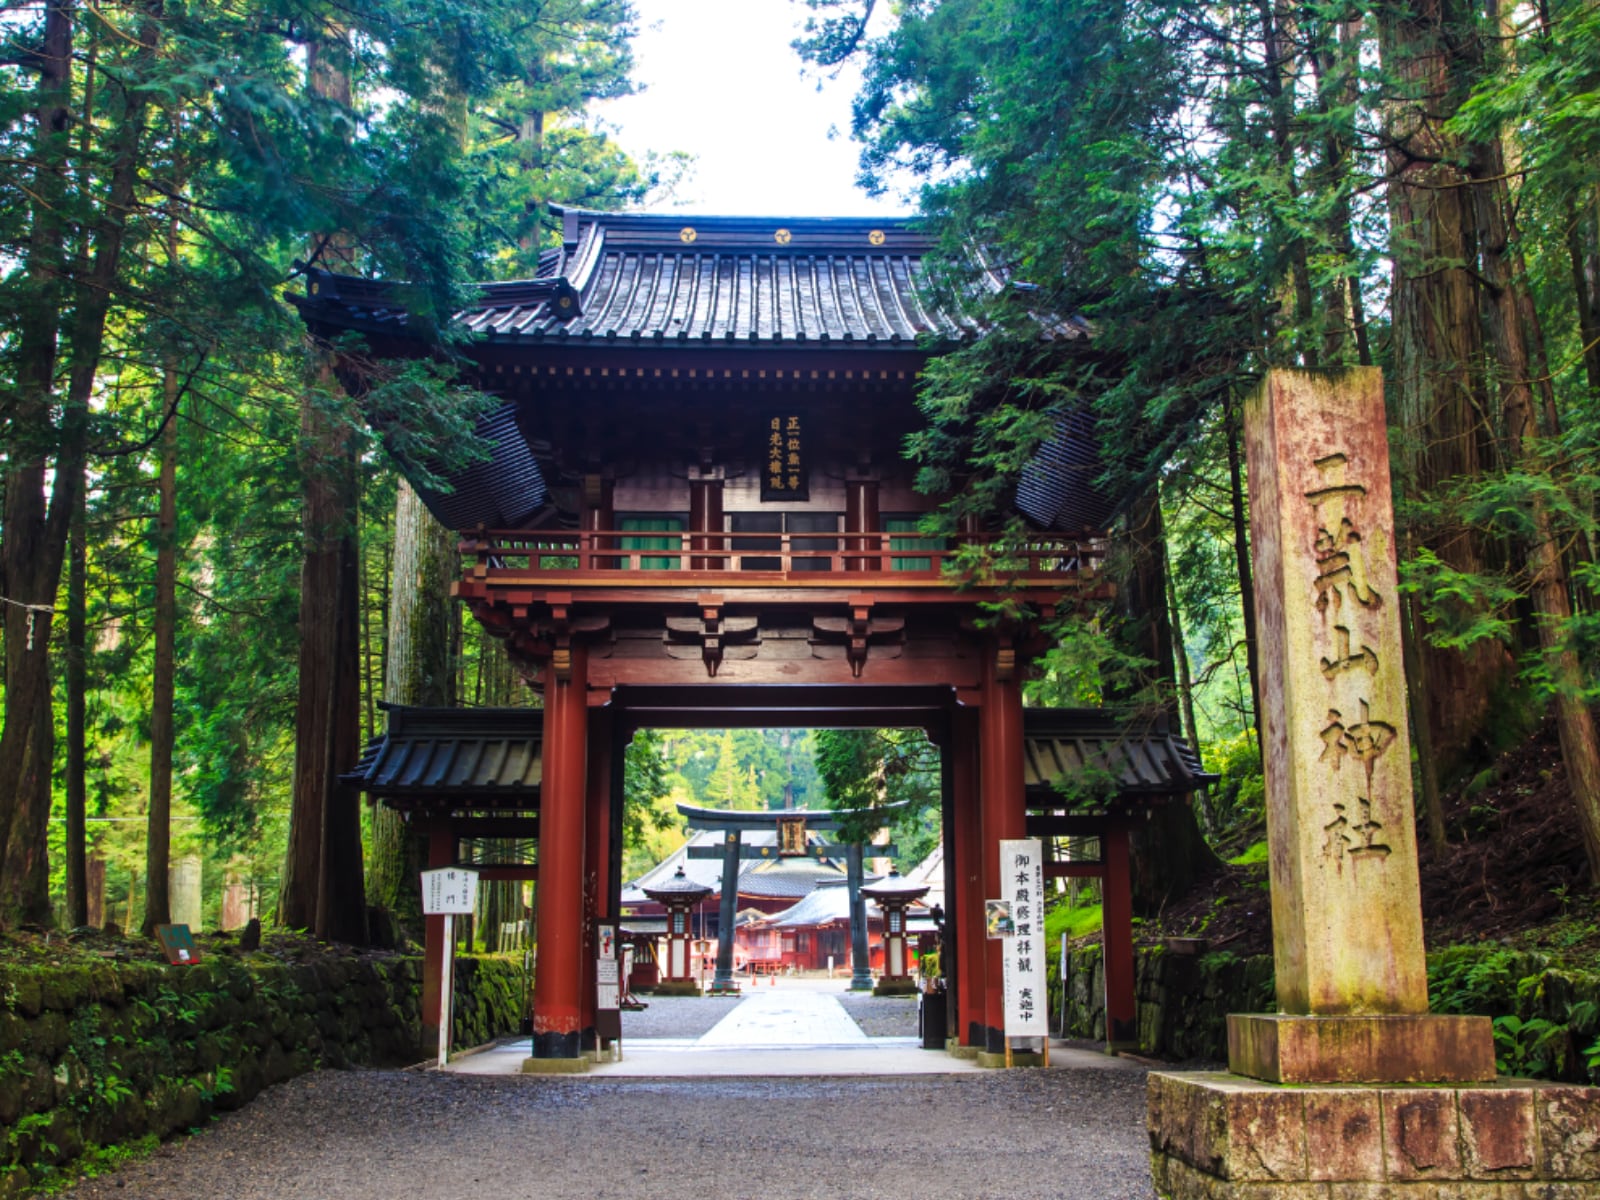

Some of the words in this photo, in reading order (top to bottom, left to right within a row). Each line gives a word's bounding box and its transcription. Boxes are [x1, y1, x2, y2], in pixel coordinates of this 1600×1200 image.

[1304, 452, 1397, 867] 二荒山神社
[1015, 854, 1033, 972] 御本殿修理拝観
[1019, 988, 1034, 1023] 実施中
